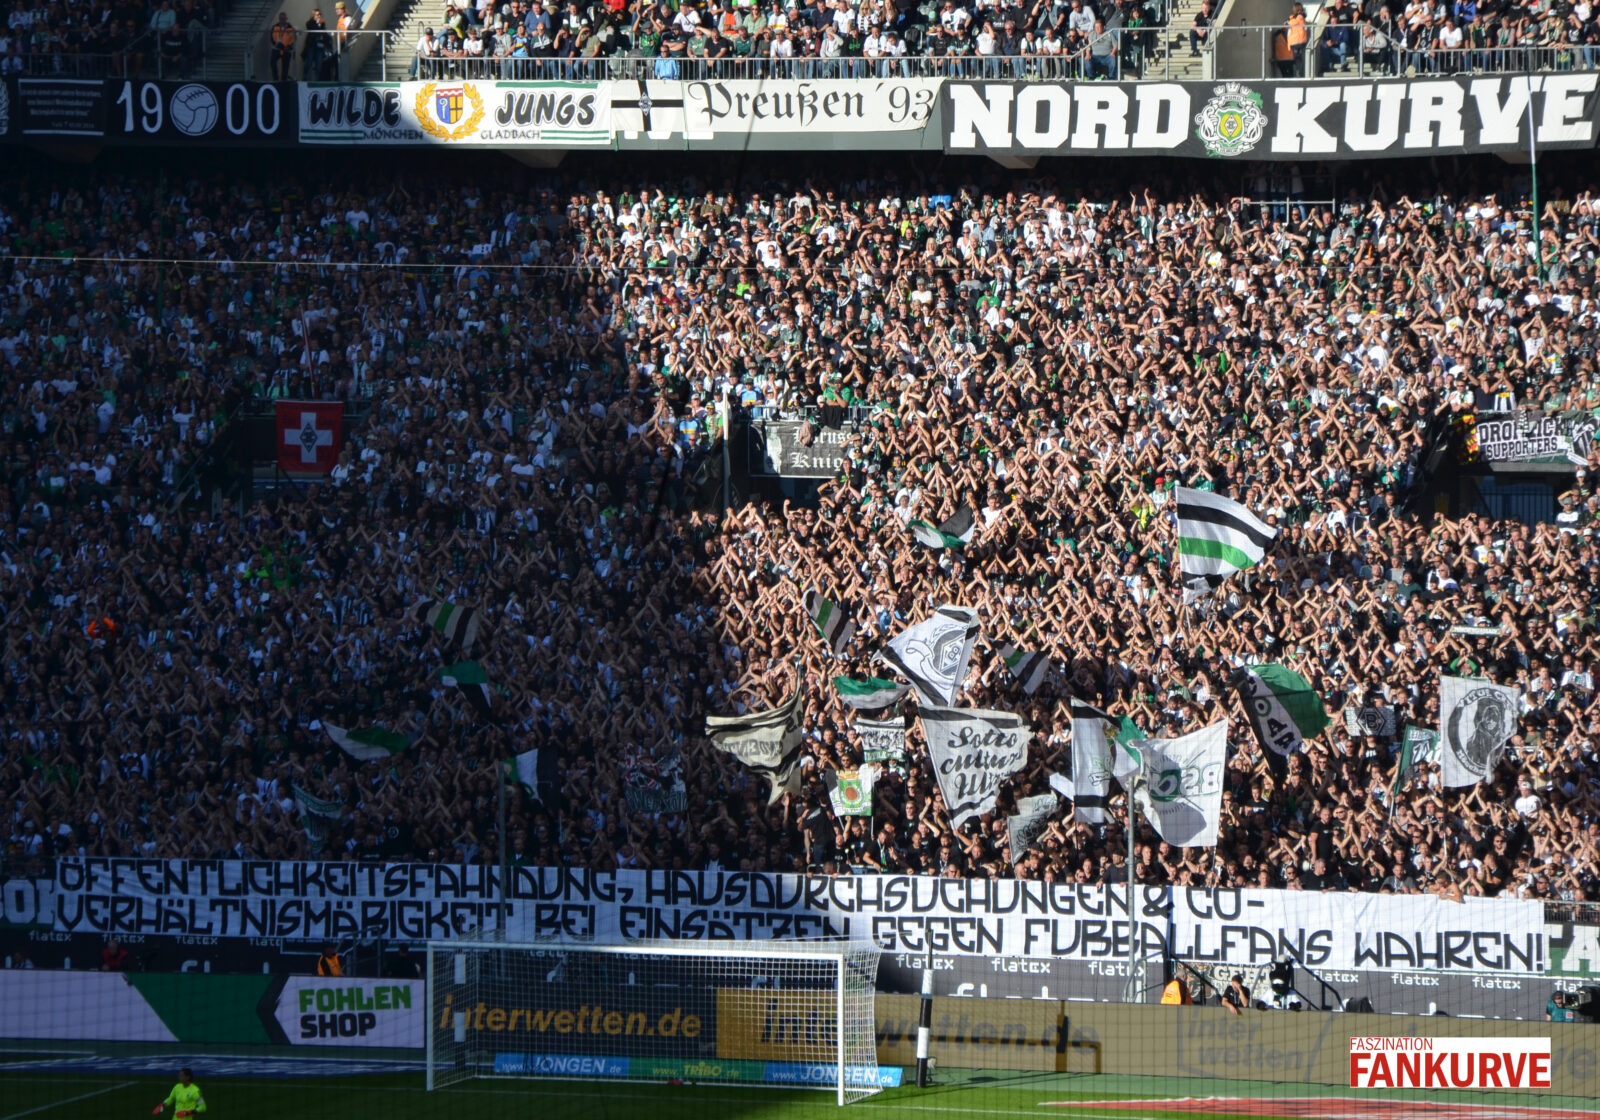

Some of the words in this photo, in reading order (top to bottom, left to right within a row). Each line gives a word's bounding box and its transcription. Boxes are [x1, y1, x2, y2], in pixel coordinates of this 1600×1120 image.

[116, 80, 163, 133] 19
[226, 83, 280, 135] 00
[308, 88, 401, 127] WILDE
[495, 90, 597, 128] JUNGS
[688, 81, 865, 127] Preußen
[950, 83, 1192, 150] NORD
[1271, 72, 1599, 155] KURVE
[363, 128, 423, 141] MÖNCHEN
[480, 129, 540, 140] GLADBACH
[1478, 415, 1564, 444] DROICK
[1486, 436, 1559, 460] SUPPORTERS
[789, 452, 844, 472] Knig
[60, 856, 634, 904] ÖFFENTLICHKEITSFAHNDUNG,
[645, 868, 1130, 917] HAUSDURCHSUCHUNGEN
[1142, 885, 1168, 917] &
[1186, 886, 1265, 921] CU-
[28, 929, 73, 943] flatex
[102, 933, 146, 945] flatex
[175, 934, 219, 946] flatex
[249, 937, 281, 947] flate
[534, 904, 595, 941] BEI
[619, 906, 850, 943] EINSÄTZEN
[872, 916, 1003, 954] GEGEN
[1355, 931, 1544, 973] WAHREN!
[991, 957, 1051, 974] flatex
[1391, 973, 1440, 986] flatex
[1471, 976, 1521, 990] flatex
[298, 984, 412, 1013] FOHLEN
[300, 1012, 377, 1039] SHOP
[1188, 1006, 1263, 1041] inter
[1198, 1042, 1304, 1070] wetten
